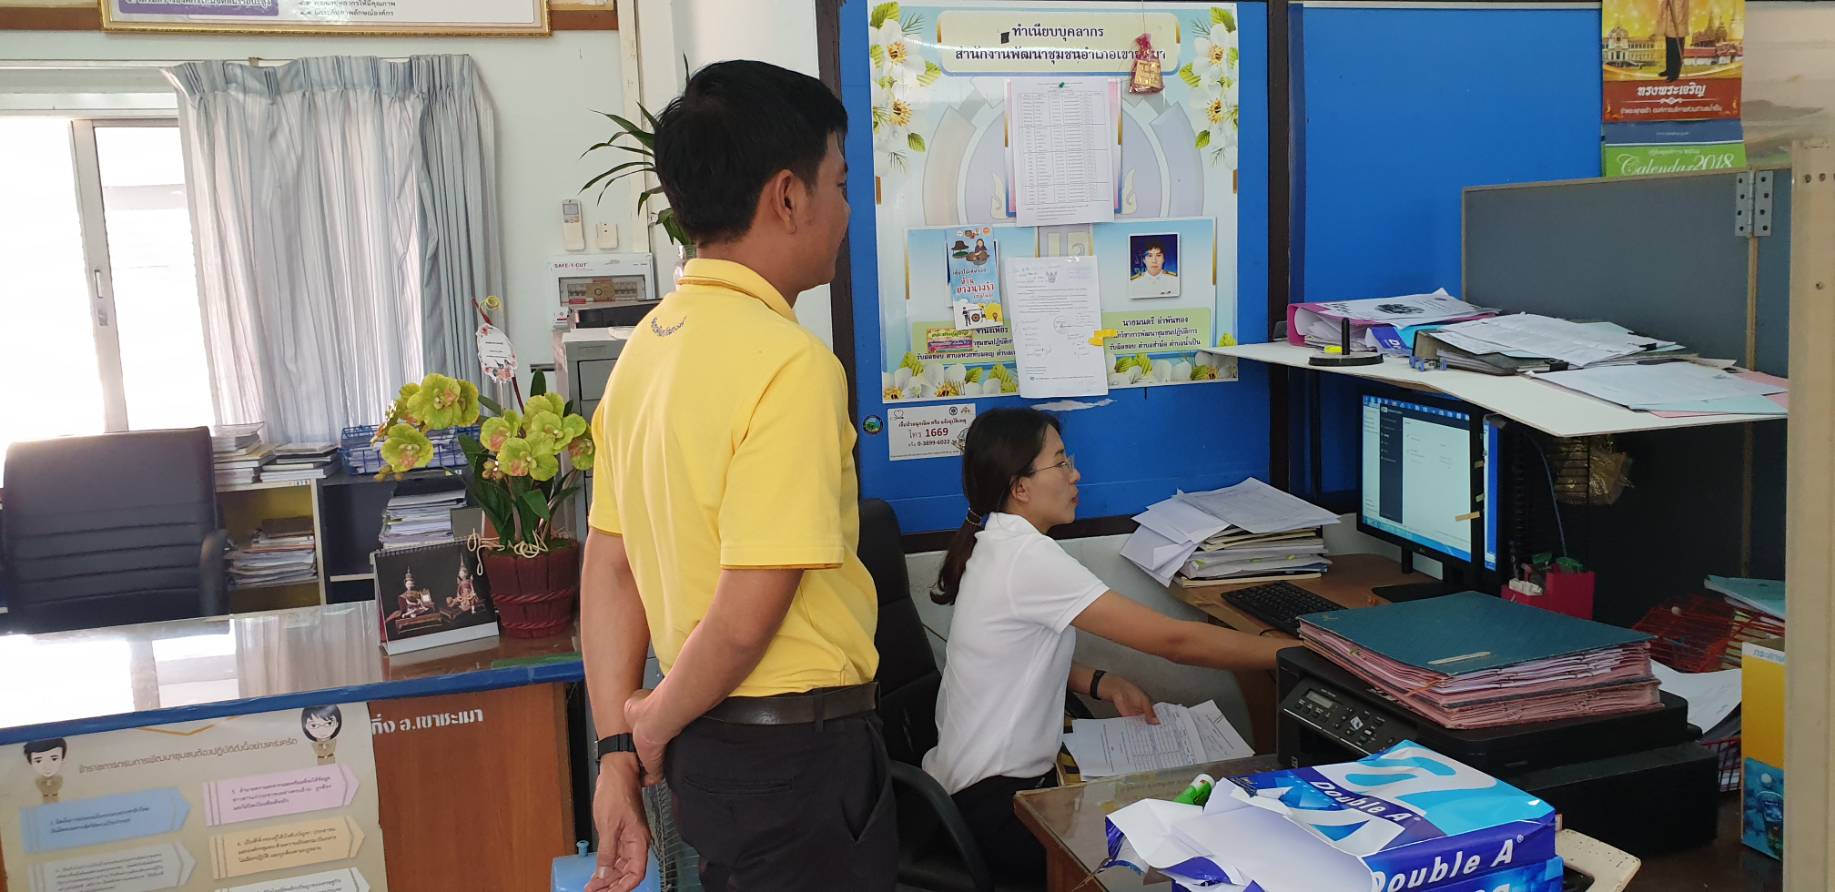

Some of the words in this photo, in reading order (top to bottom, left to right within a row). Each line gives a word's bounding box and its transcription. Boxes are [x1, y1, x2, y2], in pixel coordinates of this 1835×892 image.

[1012, 23, 1104, 41] ทำเนียบบุคลากร
[955, 45, 1166, 64] สำนักงานพัฒนาชุมชนอำเภอเขามา
[1637, 82, 1706, 97] ทรงพระเจริญ
[1695, 152, 1735, 171] 2018
[908, 429, 922, 439] โทร
[925, 427, 949, 438] 1669
[399, 708, 484, 732] อ.เขาชะเมา
[1309, 781, 1387, 815] Double
[1371, 850, 1481, 892] Double
